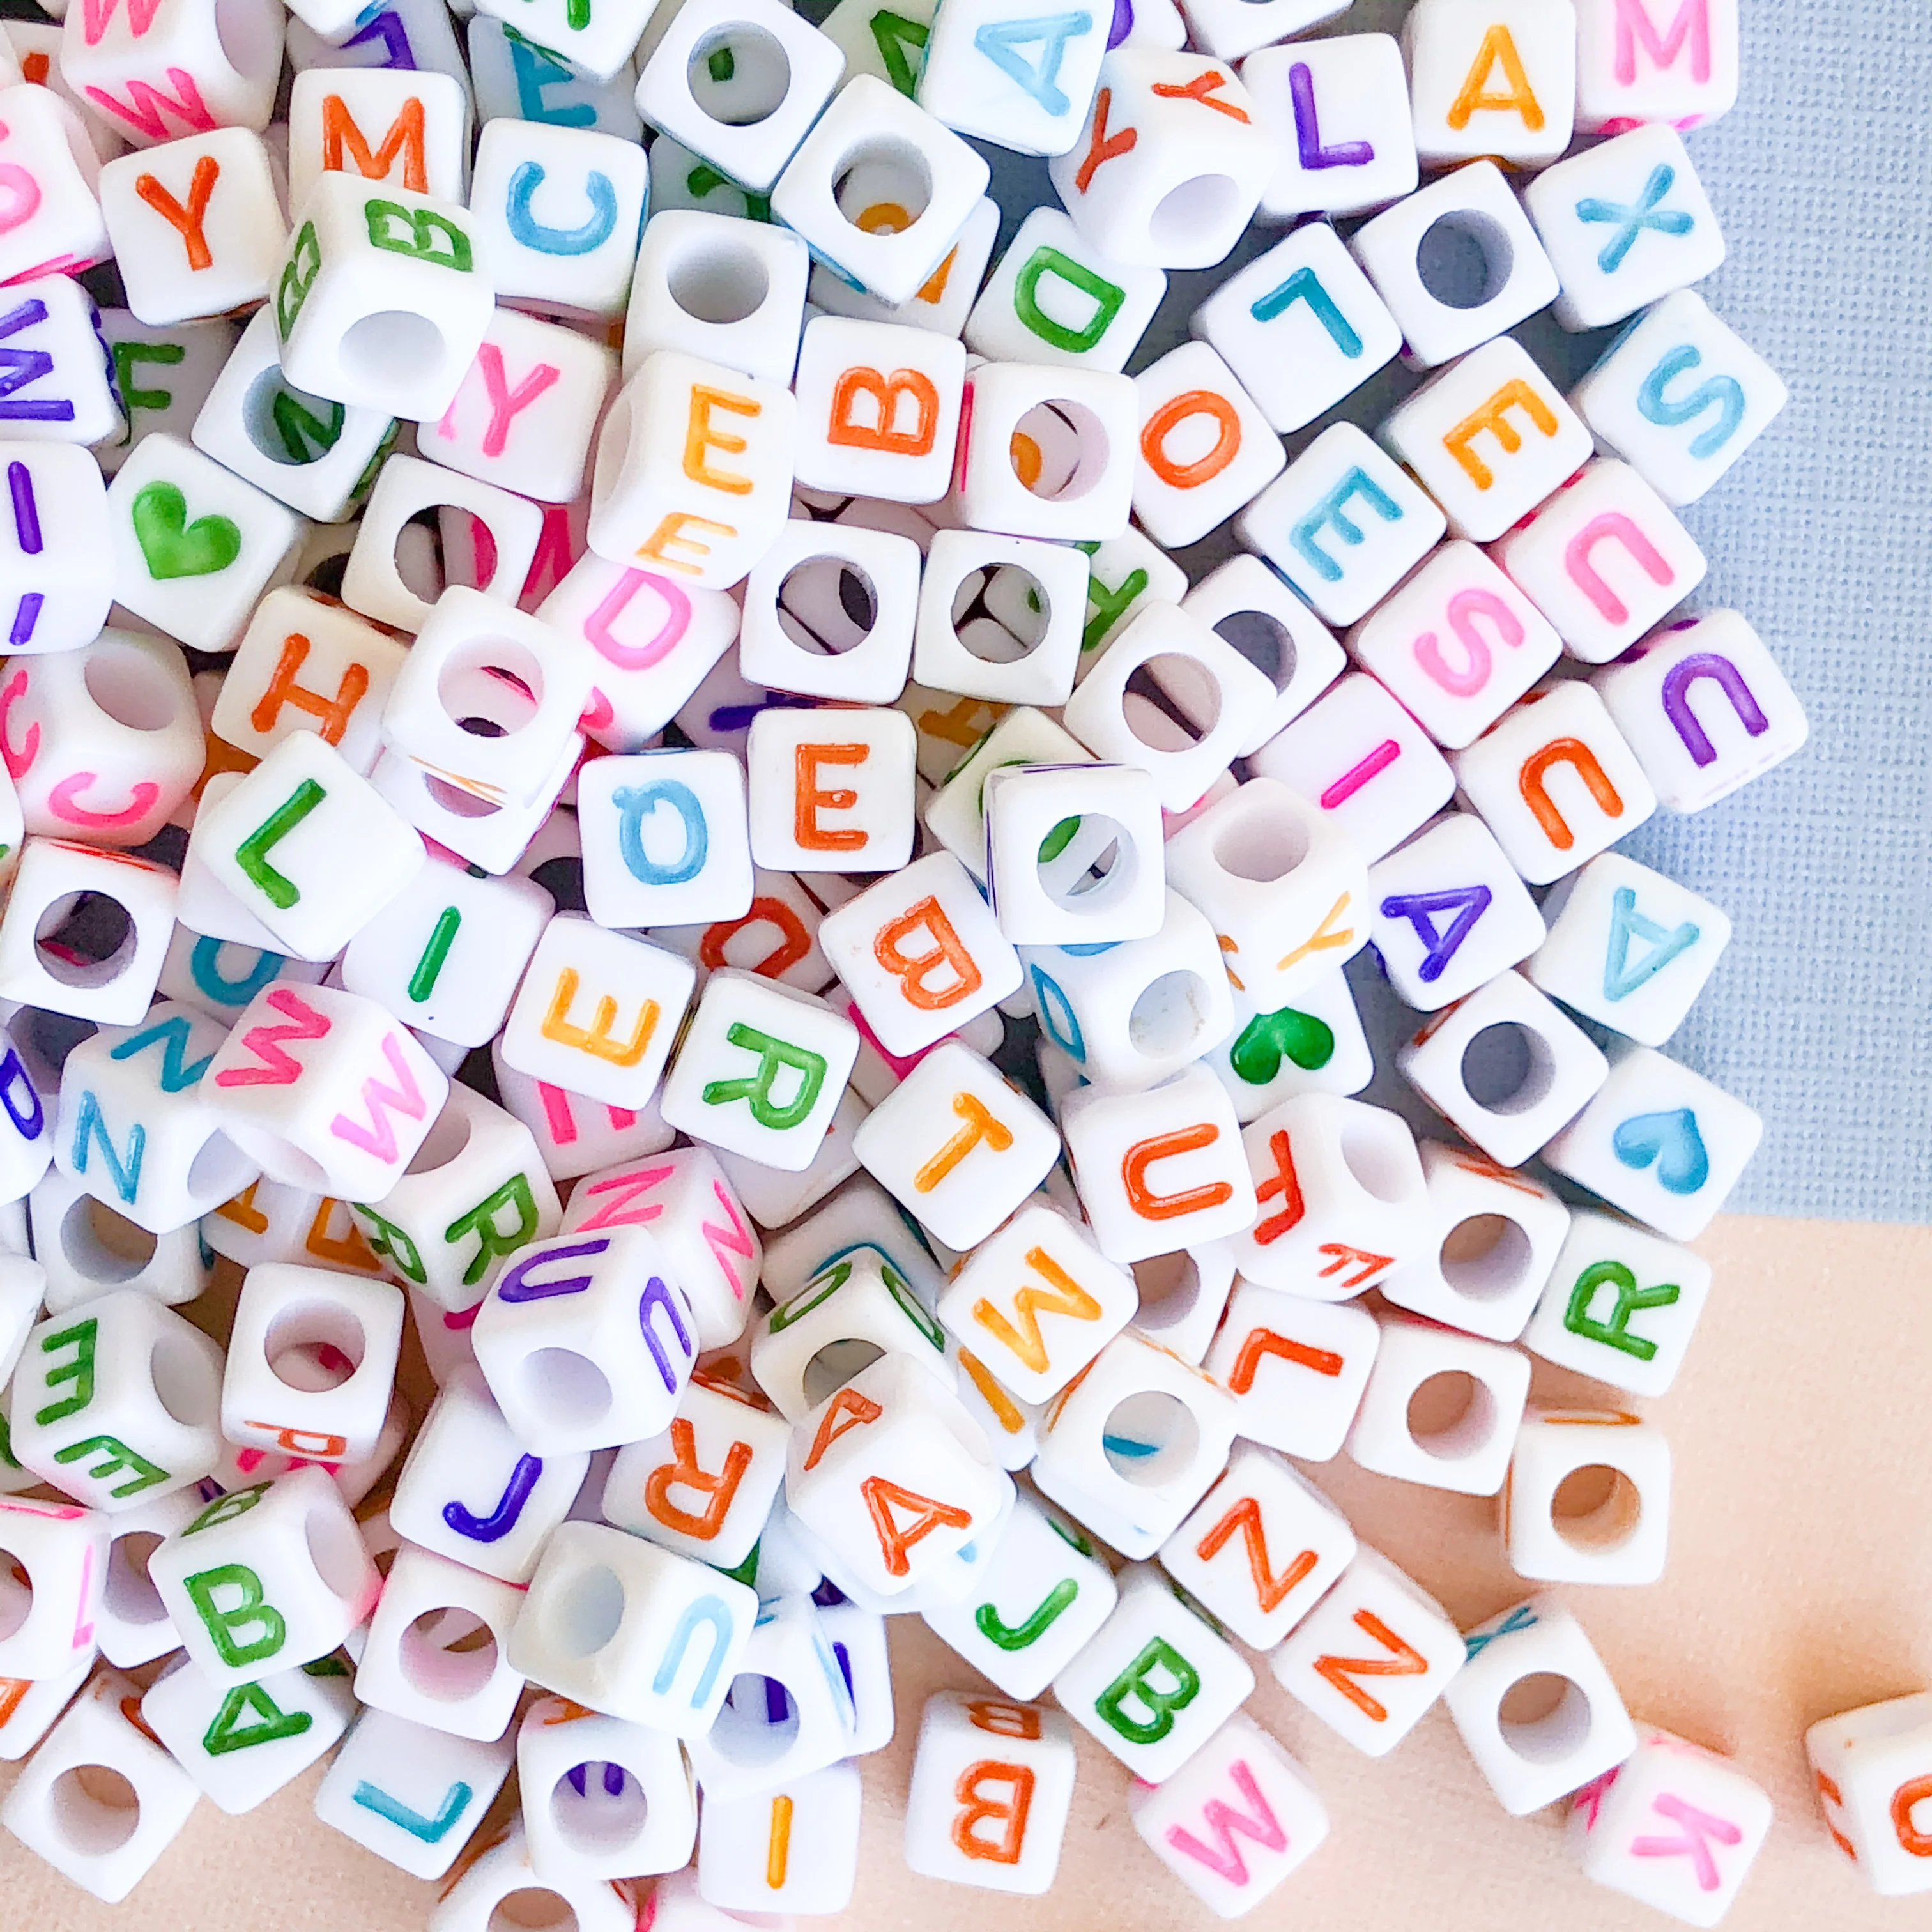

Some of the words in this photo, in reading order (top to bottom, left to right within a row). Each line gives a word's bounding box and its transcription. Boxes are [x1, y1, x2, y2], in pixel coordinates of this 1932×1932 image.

[974, 11, 1093, 116] A
[1447, 24, 1545, 131] A
[1617, 0, 1710, 85] M
[84, 68, 221, 143] W
[323, 95, 428, 194] M
[1076, 88, 1137, 194] Y
[1151, 70, 1251, 125] Y
[1289, 63, 1374, 170] L
[135, 156, 220, 270] Y
[366, 200, 473, 271] B
[506, 161, 617, 256] C
[1575, 164, 1696, 274] X
[1015, 247, 1124, 352] D
[1250, 267, 1363, 358] L
[478, 343, 560, 457] Y
[682, 384, 761, 495] E
[827, 367, 939, 456] B
[1140, 390, 1241, 490] O
[1443, 379, 1558, 491] E
[1637, 345, 1745, 456] S
[8, 461, 43, 555] I
[636, 512, 738, 576] E
[1291, 466, 1402, 581] E
[585, 567, 691, 670] D
[1567, 514, 1673, 624] U
[251, 632, 369, 747] H
[1414, 590, 1524, 696] S
[0, 669, 40, 783] C
[1662, 654, 1768, 767] U
[50, 770, 160, 829] C
[795, 743, 870, 851] E
[1320, 739, 1401, 810] I
[1519, 737, 1623, 850] U
[236, 779, 323, 907] L
[408, 907, 461, 1002] I
[874, 896, 981, 1010] B
[1278, 894, 1353, 969] Y
[1380, 885, 1492, 983] A
[1605, 887, 1699, 1000] A
[215, 988, 332, 1087] W
[541, 968, 660, 1067] E
[330, 1030, 427, 1165] W
[703, 1023, 826, 1128] R
[72, 1091, 145, 1204] N
[914, 1092, 1013, 1193] T
[1121, 1123, 1232, 1221] U
[1254, 1130, 1305, 1245] F
[445, 1172, 540, 1285] R
[498, 1239, 609, 1303] U
[1319, 1243, 1395, 1288] F
[1228, 1328, 1344, 1395] L
[1565, 1262, 1679, 1360] R
[36, 1319, 96, 1425] E
[54, 1435, 171, 1498] E
[645, 1418, 753, 1540] R
[804, 1388, 883, 1472] A
[442, 1453, 542, 1543] J
[861, 1476, 971, 1576] A
[184, 1565, 284, 1667] B
[652, 1593, 733, 1709] U
[976, 1583, 1077, 1650] J
[203, 1682, 312, 1755] A
[1095, 1637, 1199, 1744] B
[353, 1781, 472, 1843] L
[767, 1796, 793, 1890] I
[952, 1760, 1035, 1864] B
[1169, 1761, 1287, 1885] W
[1631, 1793, 1742, 1891] K
